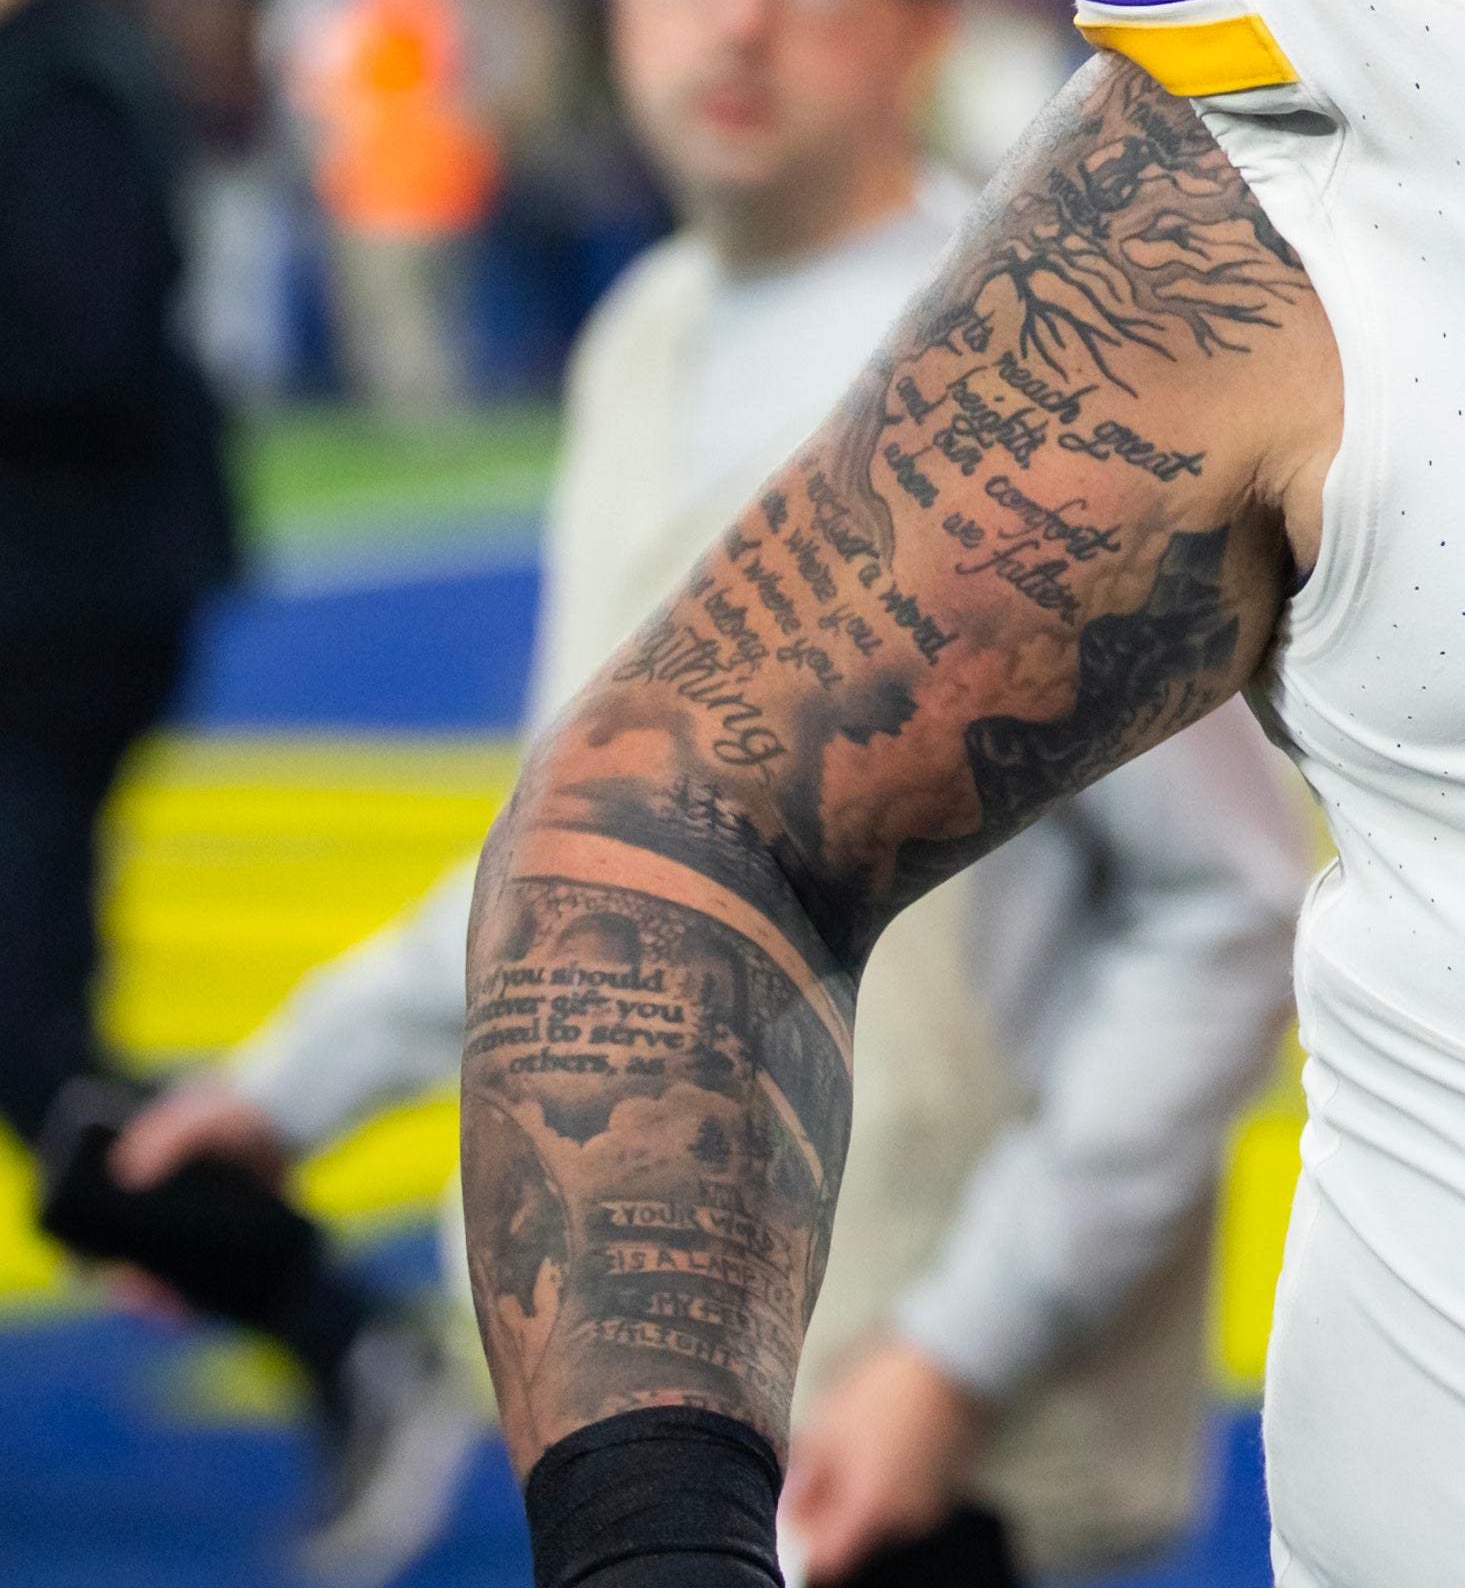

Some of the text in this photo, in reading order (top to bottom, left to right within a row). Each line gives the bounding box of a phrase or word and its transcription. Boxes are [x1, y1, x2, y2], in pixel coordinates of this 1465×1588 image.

[991, 349, 1208, 483] reach great
[895, 375, 950, 427] and
[985, 474, 1123, 562] comfort
[883, 441, 940, 508] when
[942, 513, 986, 551] we
[856, 561, 882, 590] a
[818, 602, 884, 658] you
[775, 636, 843, 692] you
[499, 964, 546, 1001] you
[547, 958, 667, 993] should
[615, 998, 686, 1023] you
[545, 1015, 583, 1044] to
[587, 1023, 687, 1051] serve
[624, 1056, 667, 1076] as
[618, 1200, 700, 1230] YOUR
[616, 1248, 648, 1272] IS
[655, 1249, 677, 1270] A
